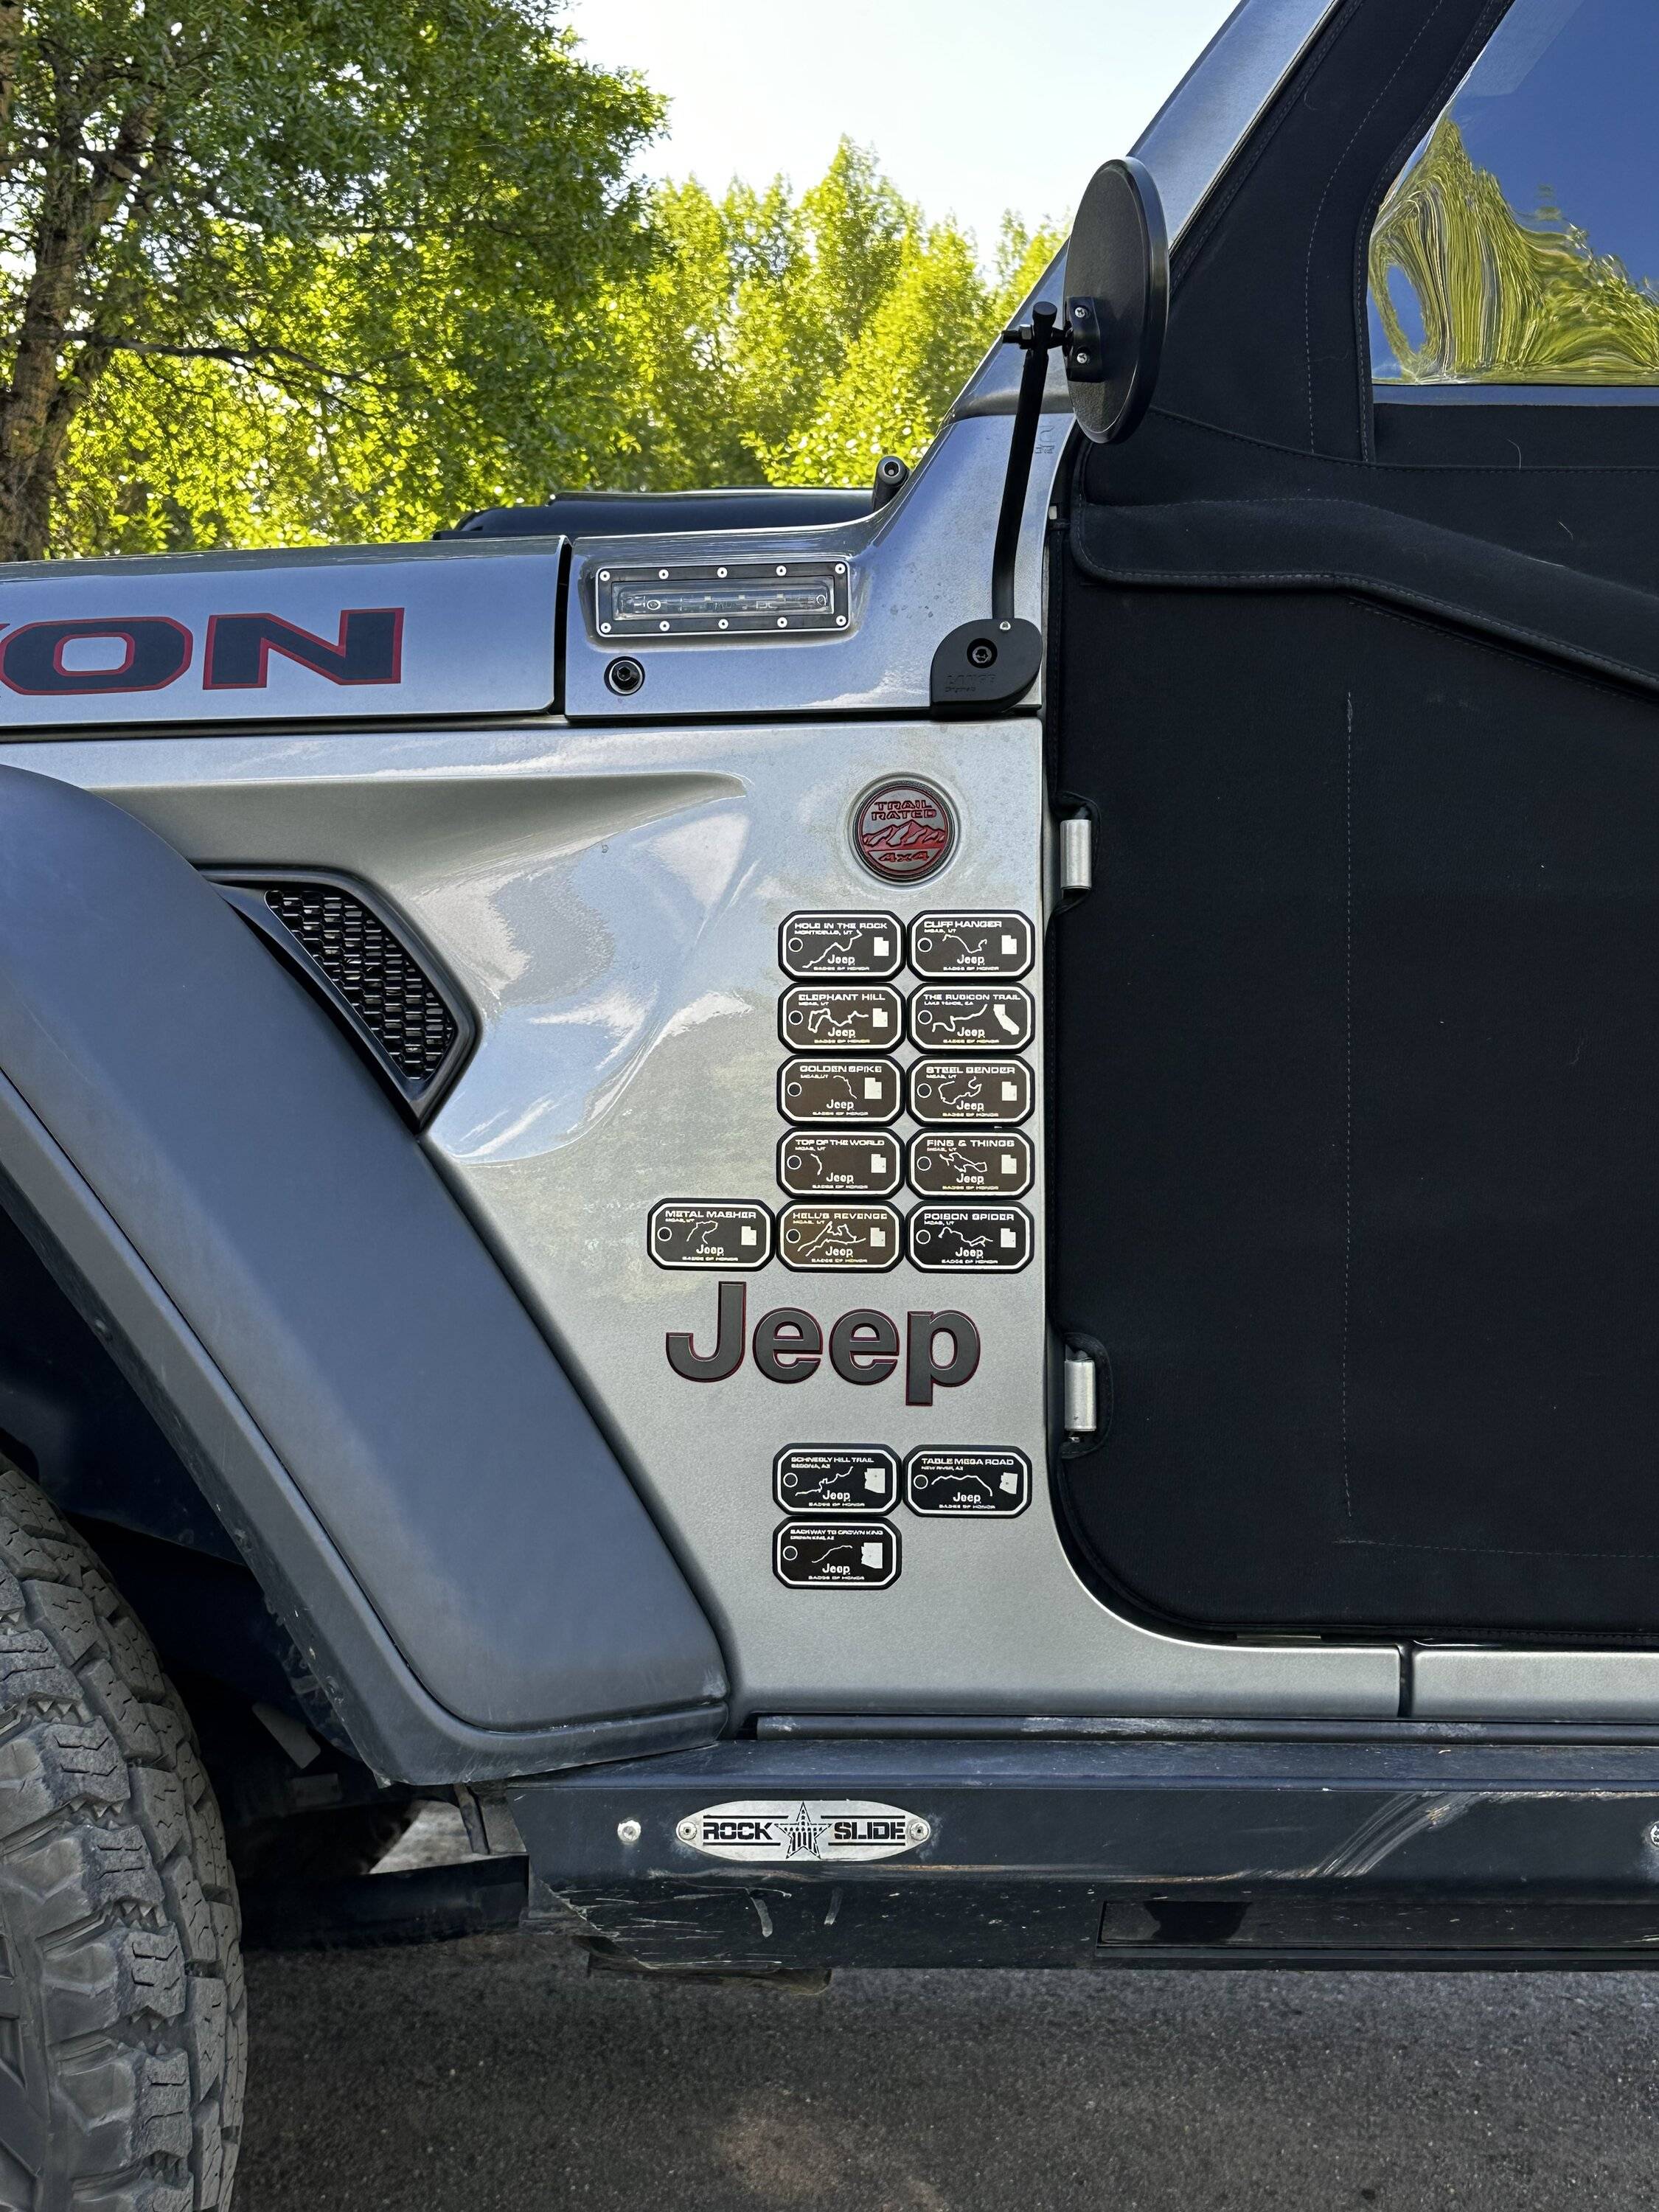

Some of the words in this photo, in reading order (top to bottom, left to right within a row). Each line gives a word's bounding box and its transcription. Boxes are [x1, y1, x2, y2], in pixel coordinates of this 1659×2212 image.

[0, 608, 405, 695] ON
[874, 800, 932, 810] TRAIL
[872, 809, 936, 821] RATED
[827, 954, 855, 965] Jeep
[957, 954, 984, 965] Jeep
[828, 1027, 855, 1038] Jeep
[957, 1027, 985, 1038] Jeep
[827, 1099, 854, 1110] Jeep
[957, 1100, 984, 1112] Jeep
[826, 1172, 854, 1184] Jeep
[956, 1173, 984, 1185] Jeep
[665, 1210, 704, 1218] METAL
[696, 1244, 724, 1256] Jeep
[826, 1246, 853, 1257] Jeep
[956, 1247, 983, 1259] Jeep
[666, 1281, 981, 1406] Jeep
[823, 1490, 850, 1502] Jeep
[953, 1492, 981, 1503] Jeep
[822, 1563, 850, 1575] Jeep
[703, 1822, 774, 1840] ROCK
[834, 1821, 905, 1840] SLIDE
